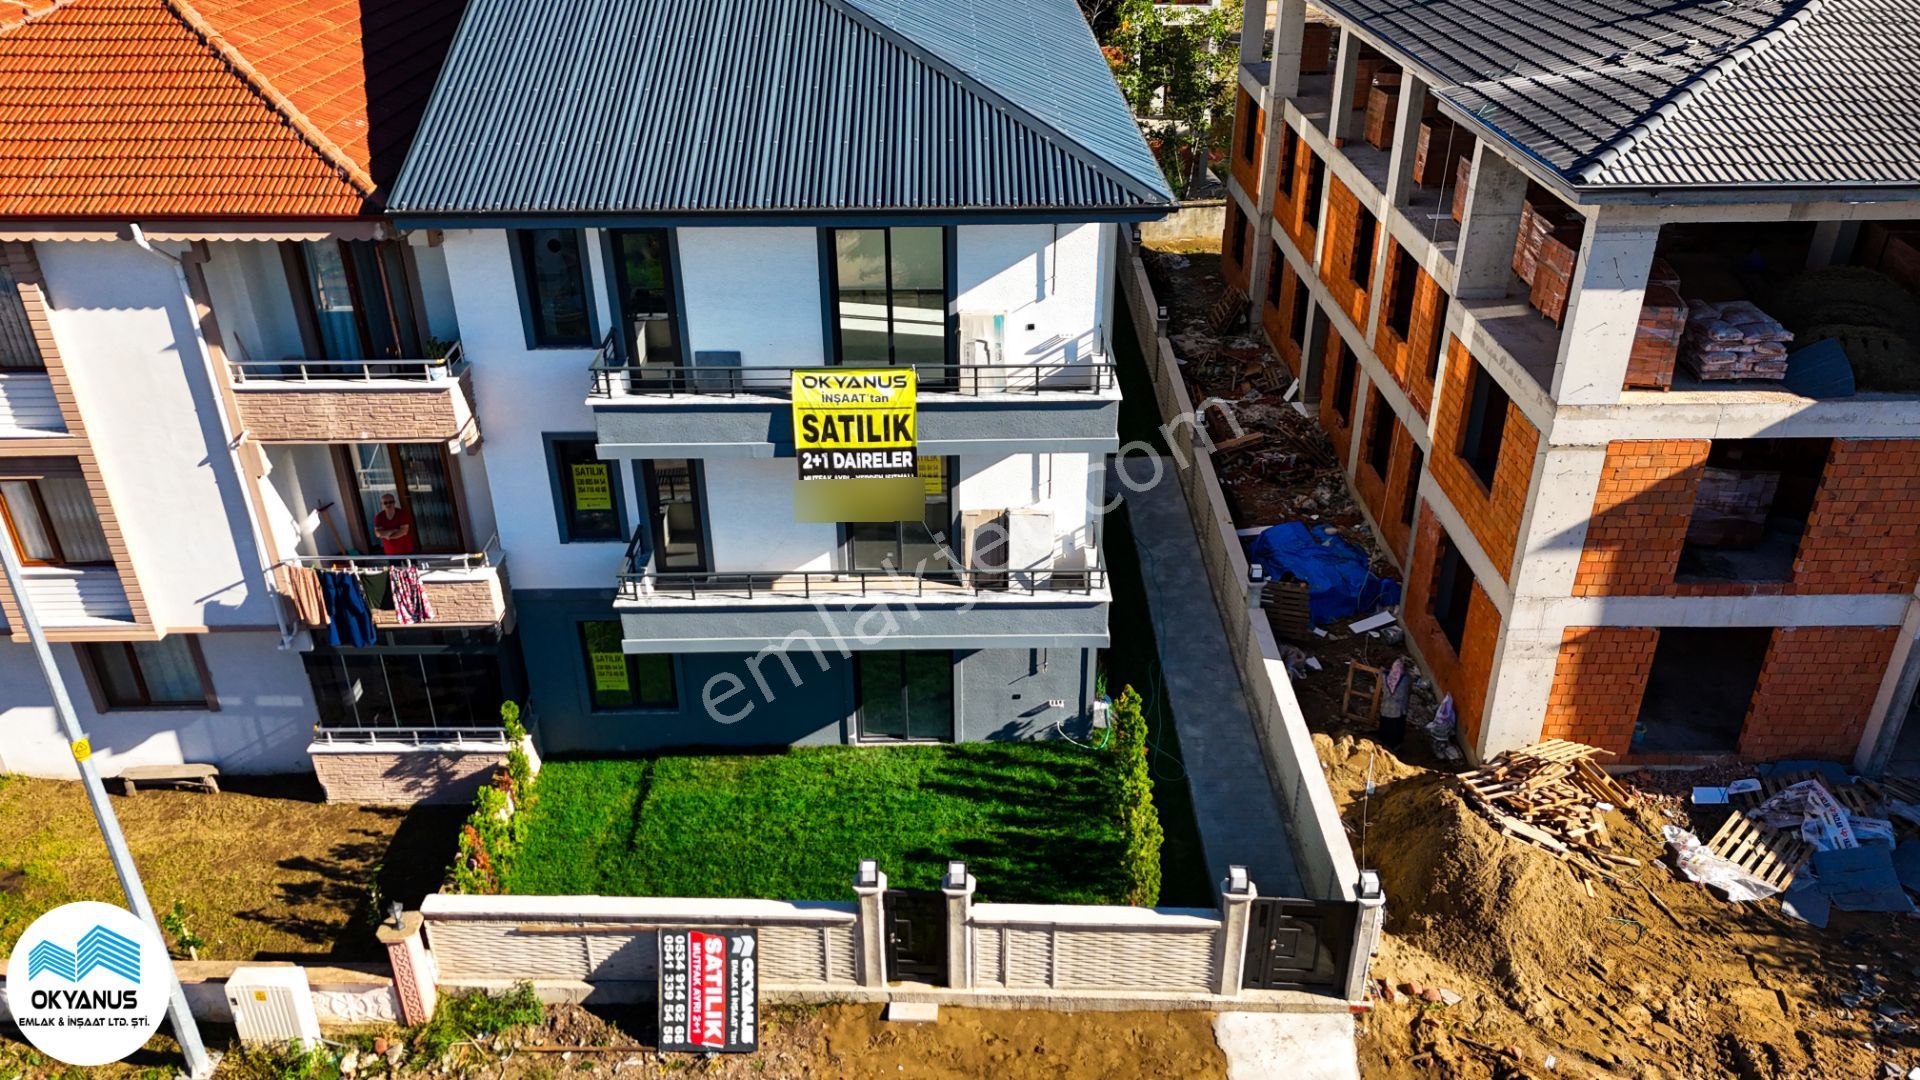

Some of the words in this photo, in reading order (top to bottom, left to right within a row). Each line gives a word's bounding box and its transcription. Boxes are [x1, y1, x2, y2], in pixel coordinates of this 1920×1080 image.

[802, 375, 907, 389] OKYANUS
[802, 414, 913, 443] SATILIK
[575, 467, 605, 476] SATILIK
[802, 452, 829, 469] 2+1
[664, 935, 674, 969] 0541
[675, 935, 686, 971] 0534
[692, 942, 702, 986] MUTFAK
[664, 974, 674, 1001] 339
[675, 973, 686, 1001] 914
[692, 987, 702, 1013] AYRI
[704, 937, 723, 1040] SATILIK
[663, 1004, 674, 1023] 54
[675, 1003, 685, 1022] 62
[741, 957, 754, 1044] OKYANUS
[663, 1025, 674, 1044] 58
[674, 1025, 685, 1044] 68
[692, 1015, 702, 1034] 2+1
